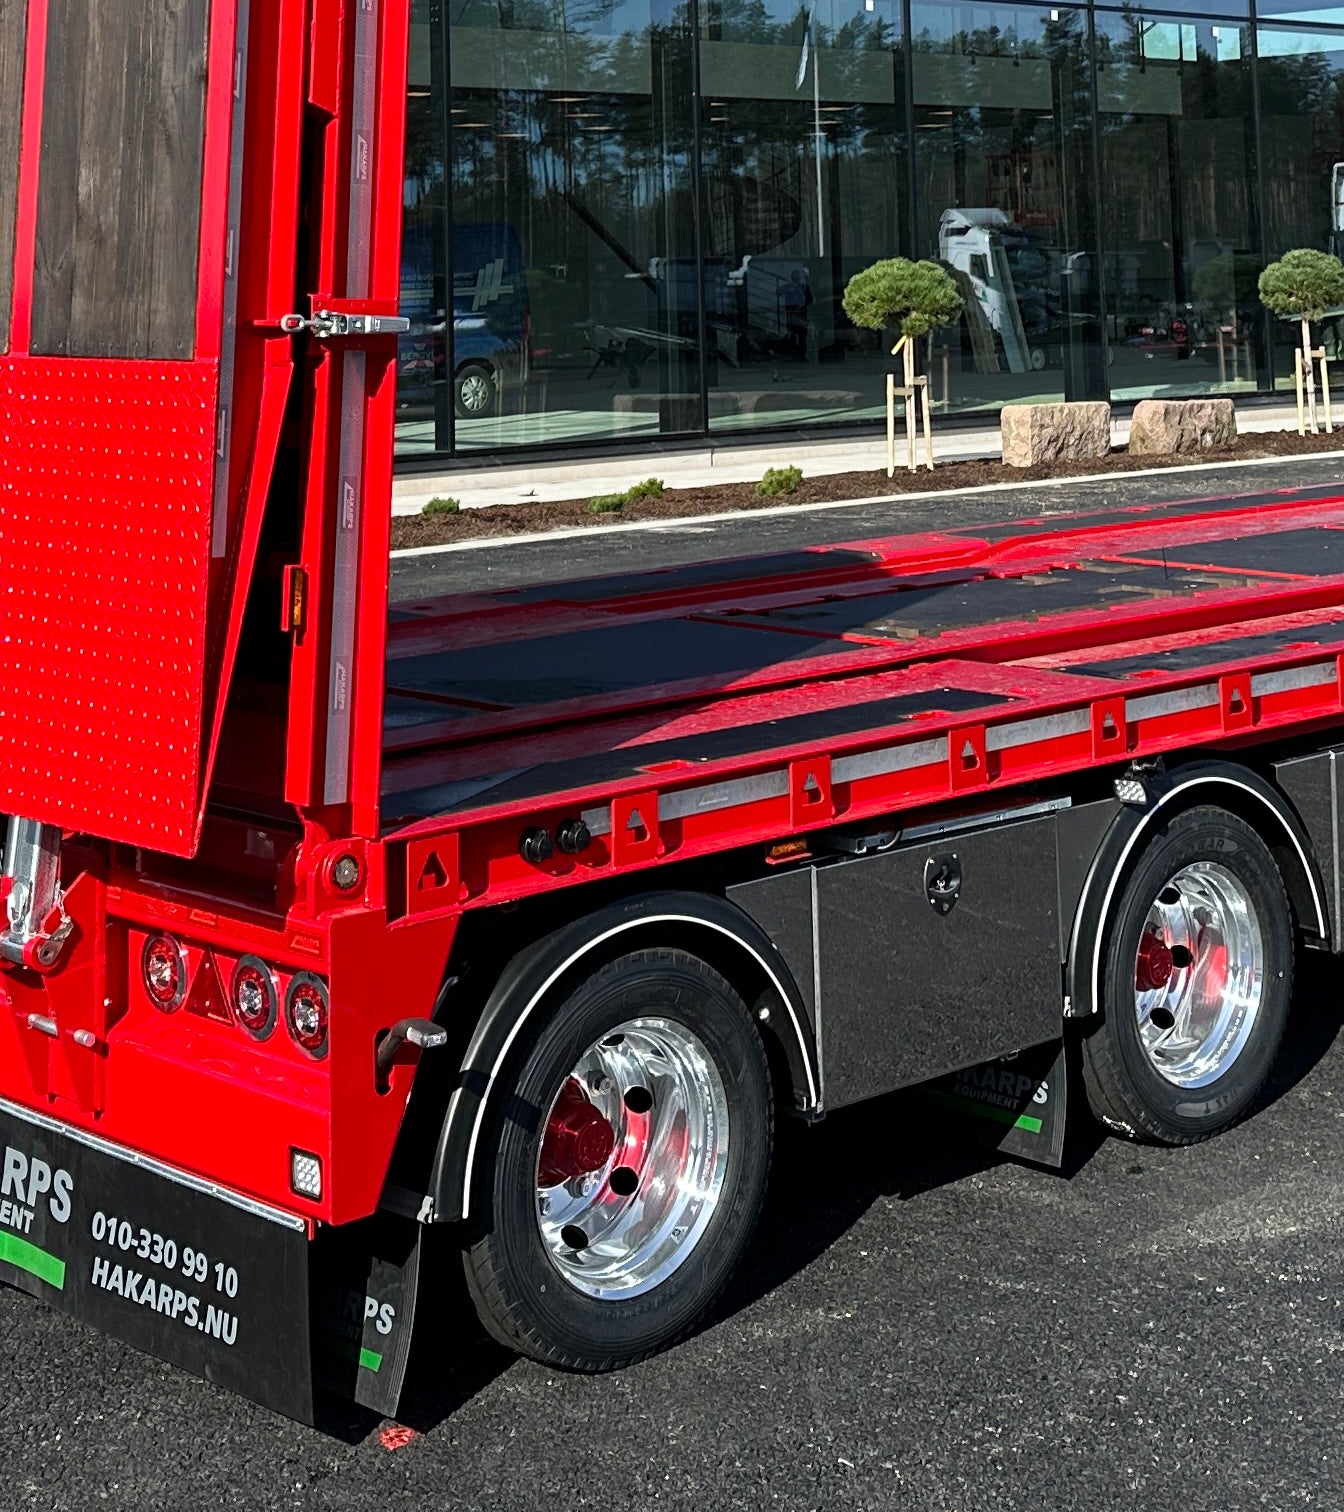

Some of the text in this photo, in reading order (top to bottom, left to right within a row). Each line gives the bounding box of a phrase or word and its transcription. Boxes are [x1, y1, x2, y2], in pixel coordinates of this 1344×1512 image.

[92, 1211, 238, 1298] 010-330 99 10
[91, 1257, 238, 1345] HAKARPS.NU
